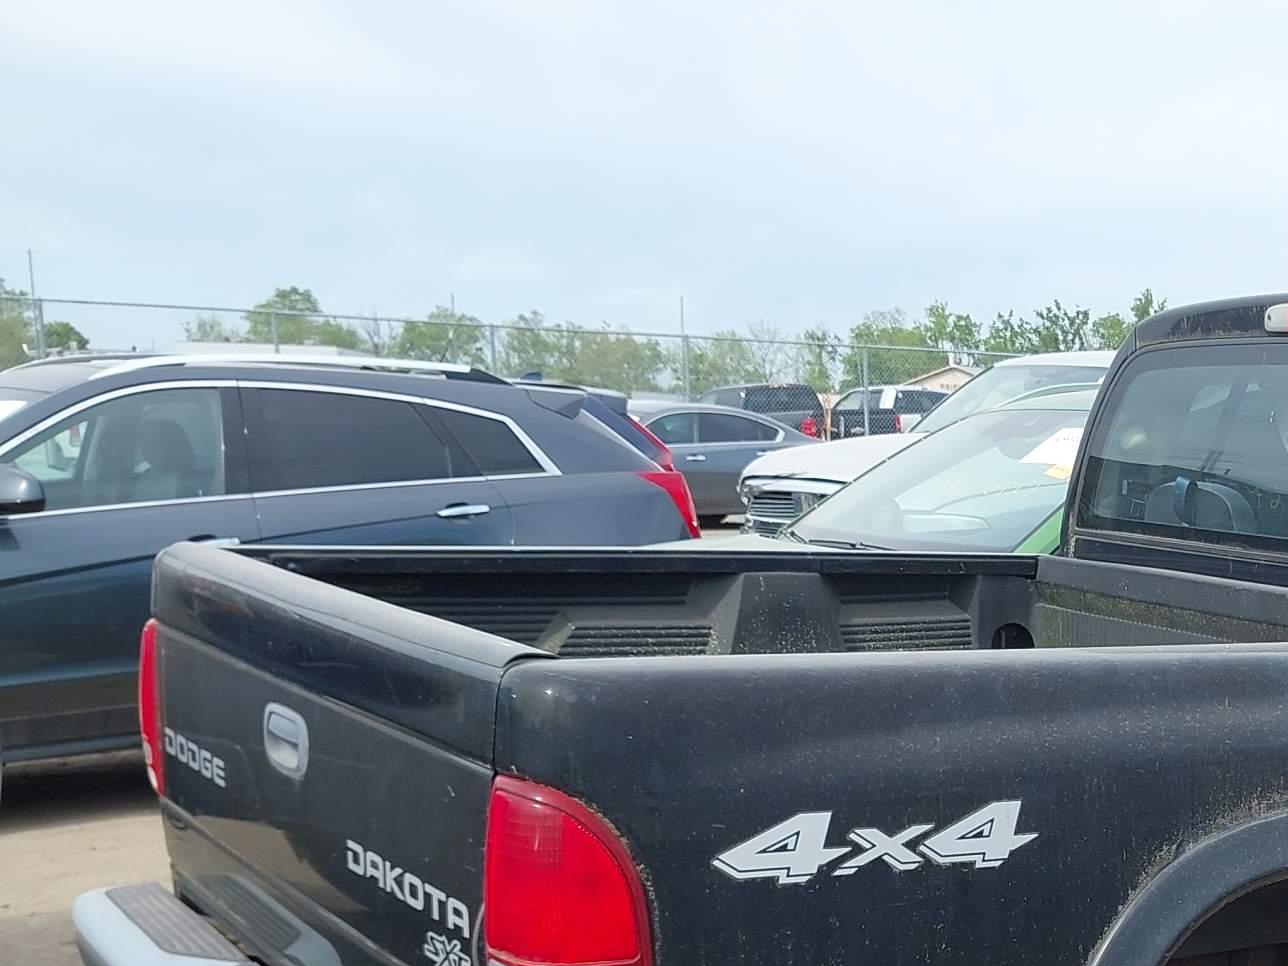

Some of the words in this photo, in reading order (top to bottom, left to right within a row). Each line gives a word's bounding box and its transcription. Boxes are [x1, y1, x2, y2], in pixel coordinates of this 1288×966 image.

[164, 726, 227, 788] DODGE
[711, 800, 1040, 885] 4x4
[346, 838, 470, 939] DAKOTA
